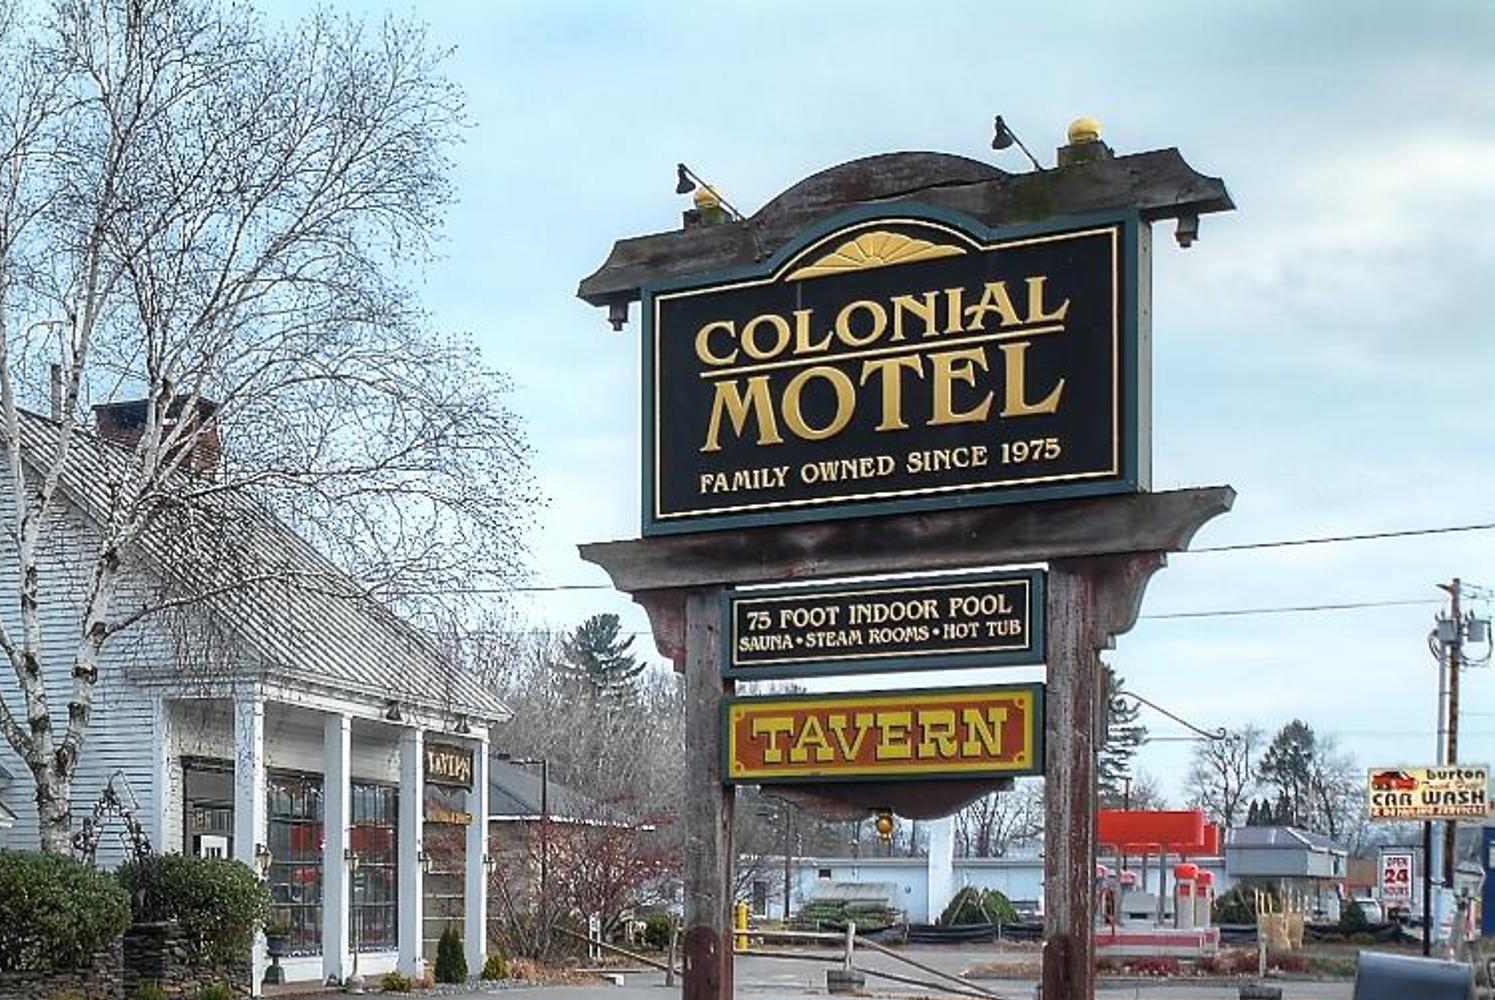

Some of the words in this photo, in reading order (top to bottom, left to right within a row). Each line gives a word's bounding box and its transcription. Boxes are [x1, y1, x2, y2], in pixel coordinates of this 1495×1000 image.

[695, 276, 1070, 366] COLONIAL
[700, 342, 1065, 451] MOTEL
[700, 466, 790, 493] FAMILY
[801, 456, 895, 483] OWNED
[907, 446, 988, 473] SINCE
[1001, 438, 1061, 464] 1975
[739, 634, 793, 652] SAUNA
[806, 631, 863, 648] STEAM
[869, 625, 930, 643] ROOMS
[943, 622, 979, 640] HOT
[987, 619, 1022, 637] TUB
[747, 611, 772, 631] 75
[780, 606, 840, 629] FOOT
[849, 600, 940, 625] INDOOR
[949, 594, 1012, 618] POOL
[752, 707, 1007, 763] TAVERN
[1372, 793, 1412, 806] CAR
[1422, 789, 1485, 804] WASH
[1384, 869, 1408, 883] 24
